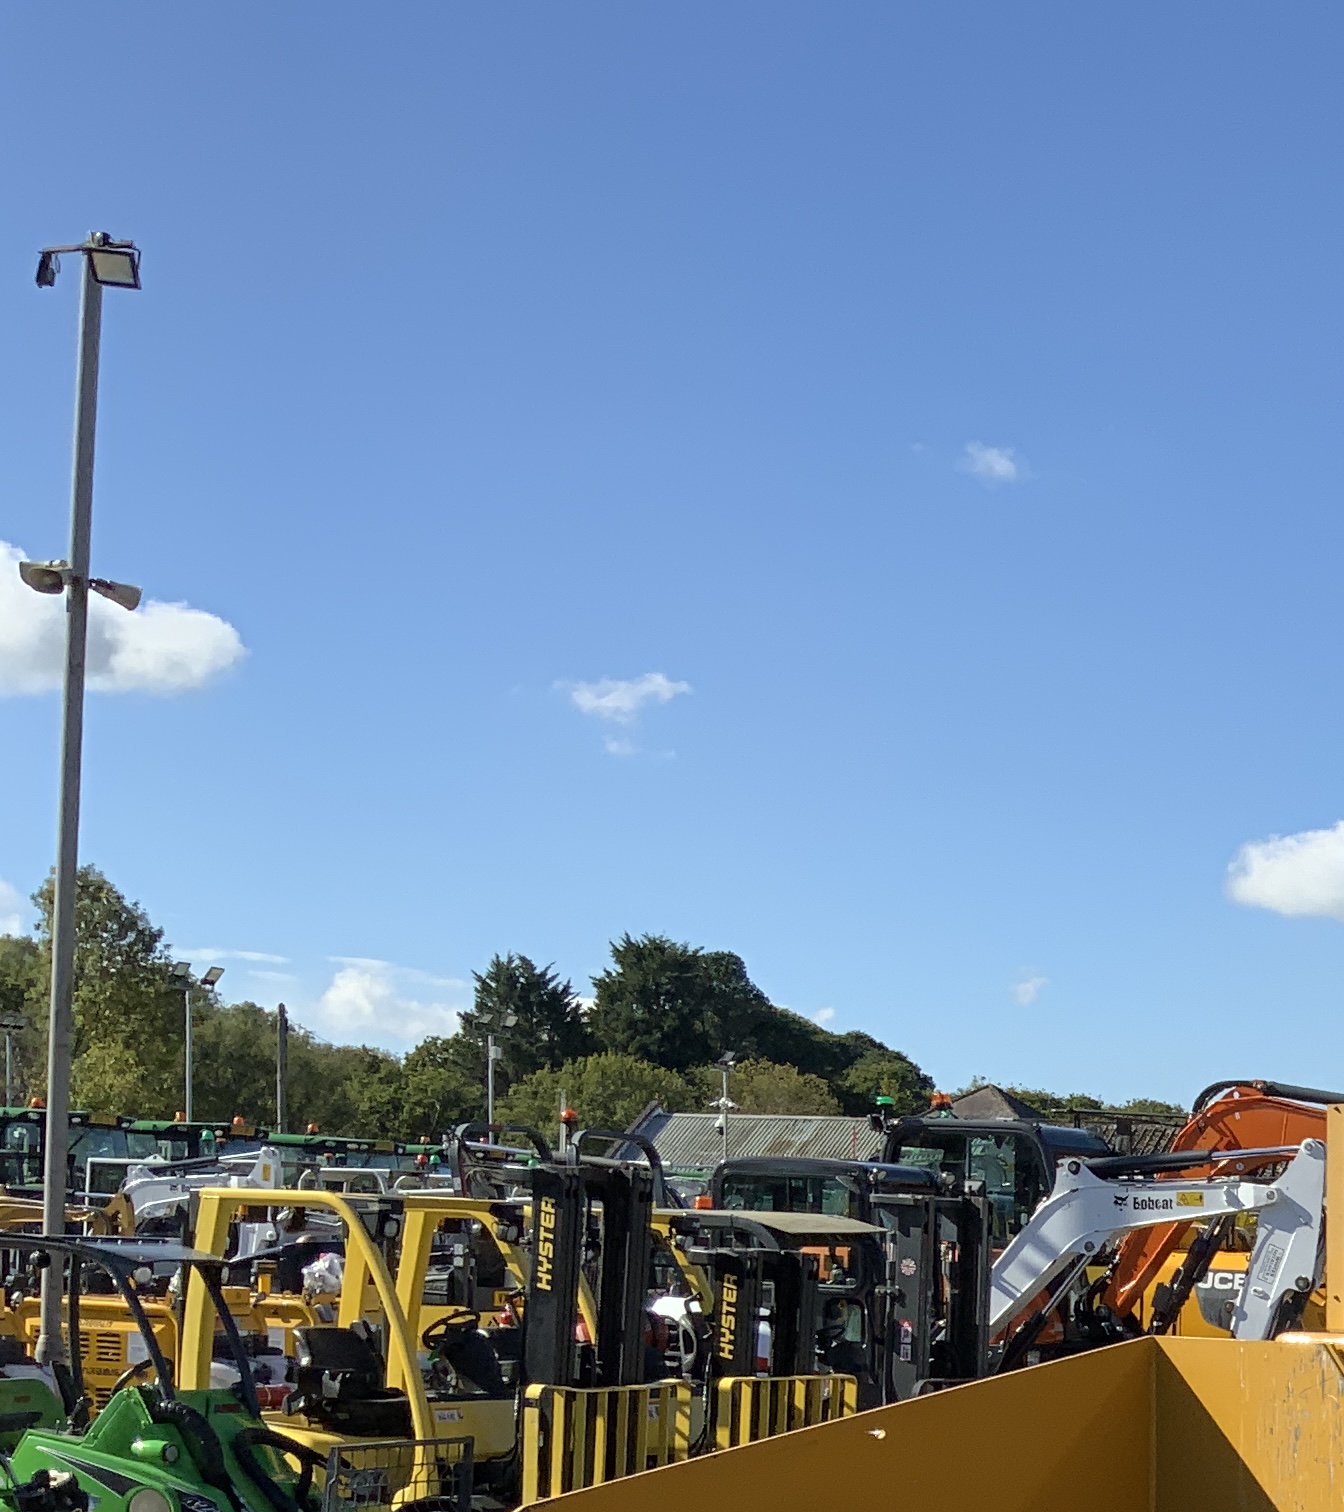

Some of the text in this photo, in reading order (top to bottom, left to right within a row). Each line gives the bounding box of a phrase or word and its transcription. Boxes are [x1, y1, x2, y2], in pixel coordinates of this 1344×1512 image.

[536, 1196, 556, 1292] HYSTER
[1132, 1196, 1174, 1210] Bobcat
[719, 1273, 738, 1361] HYSTER
